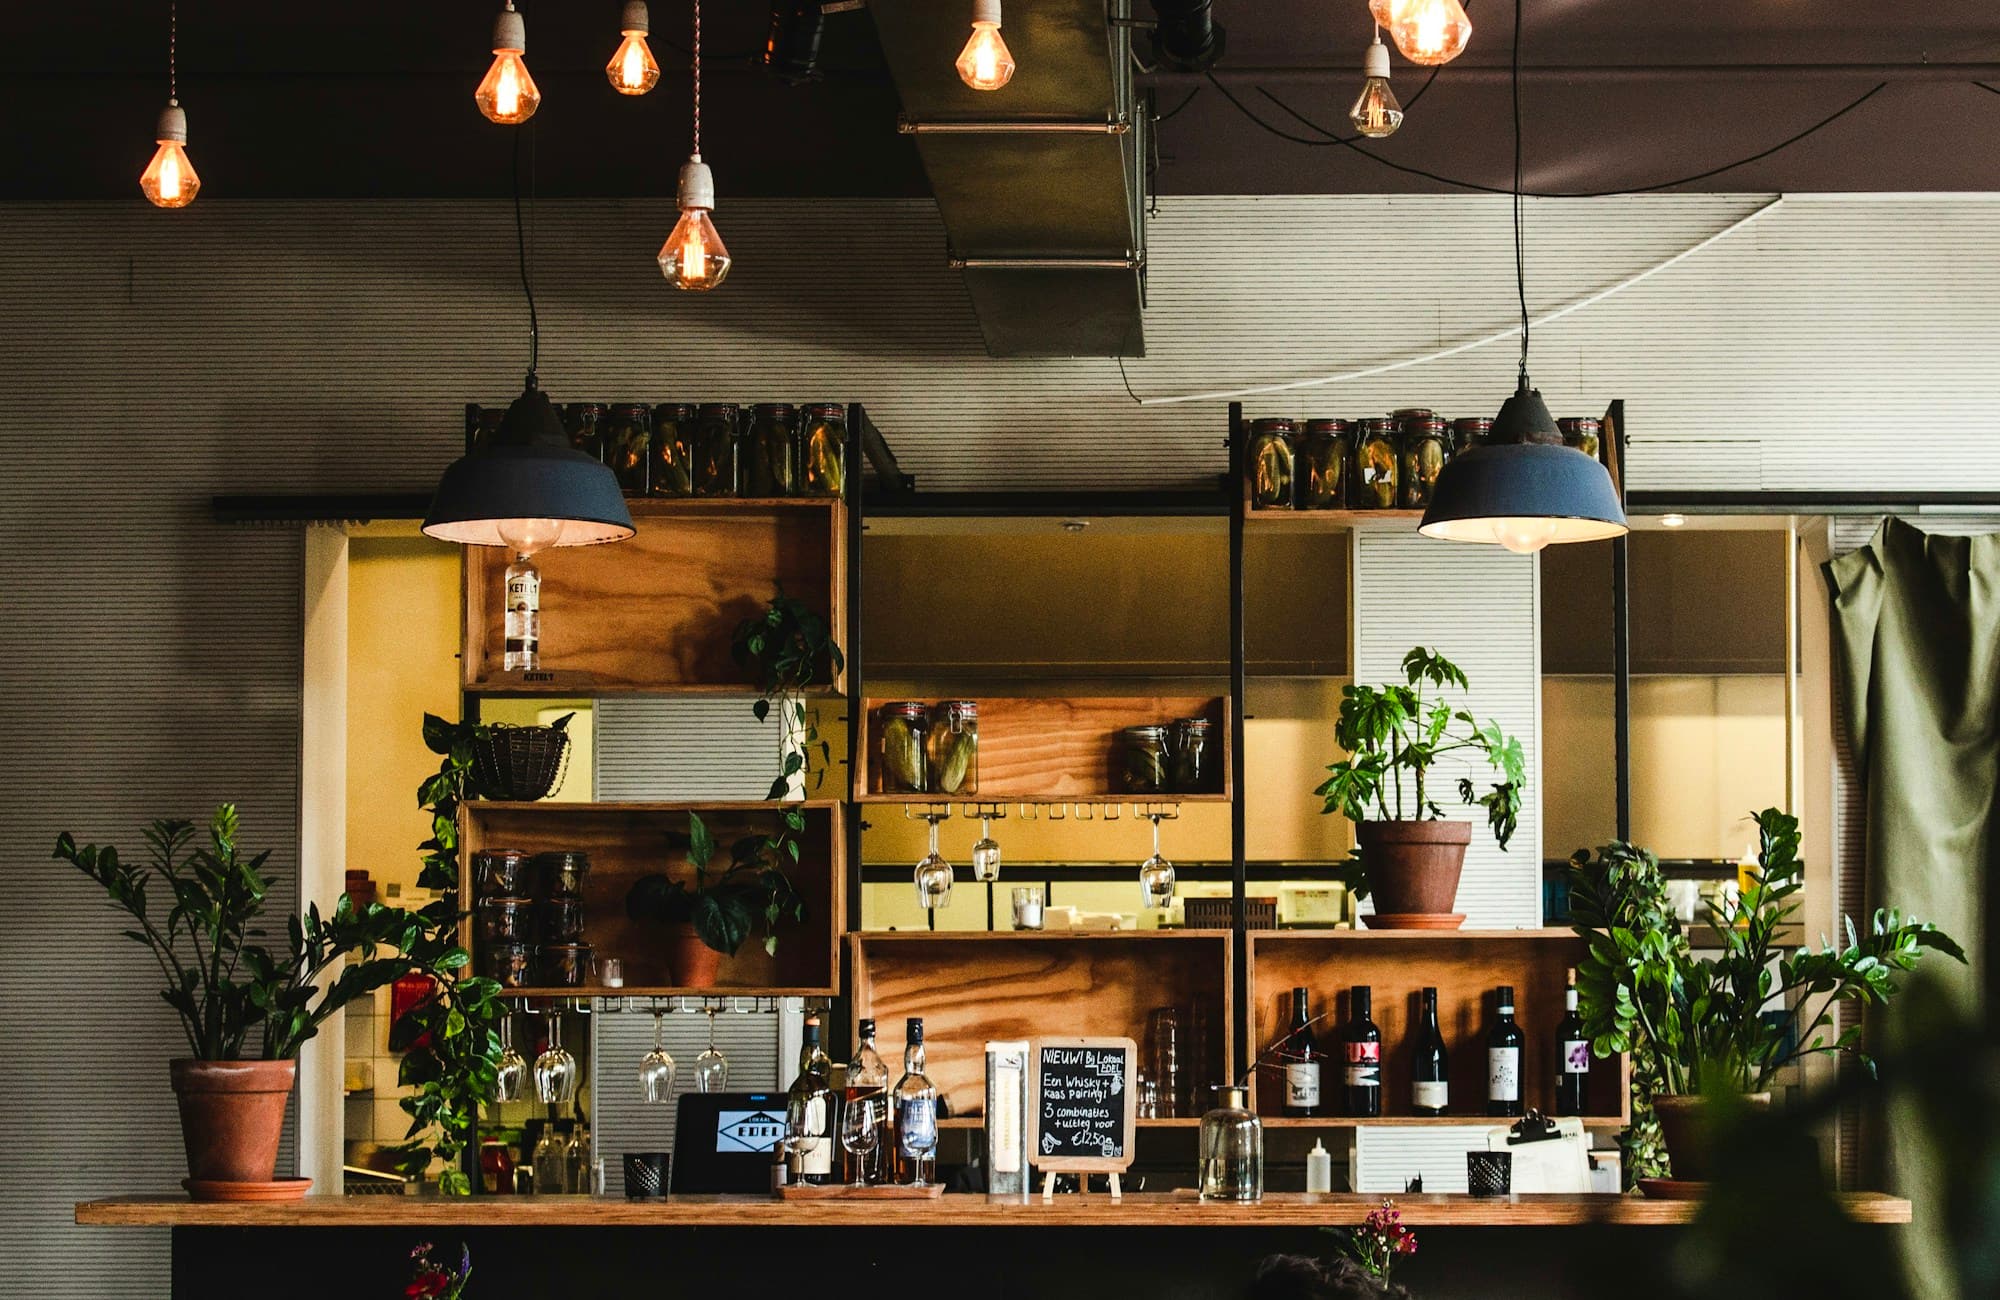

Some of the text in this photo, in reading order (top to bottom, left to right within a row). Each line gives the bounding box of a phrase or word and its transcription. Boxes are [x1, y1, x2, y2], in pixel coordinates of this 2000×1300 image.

[509, 583, 537, 593] KETL1
[1042, 1049, 1083, 1064] NIEUW!
[1101, 1064, 1122, 1074] EDEL
[1043, 1072, 1062, 1087] Een
[1044, 1102, 1110, 1118] 3 combinaties
[1094, 1120, 1115, 1129] voor
[1071, 1130, 1105, 1146] €12,50
